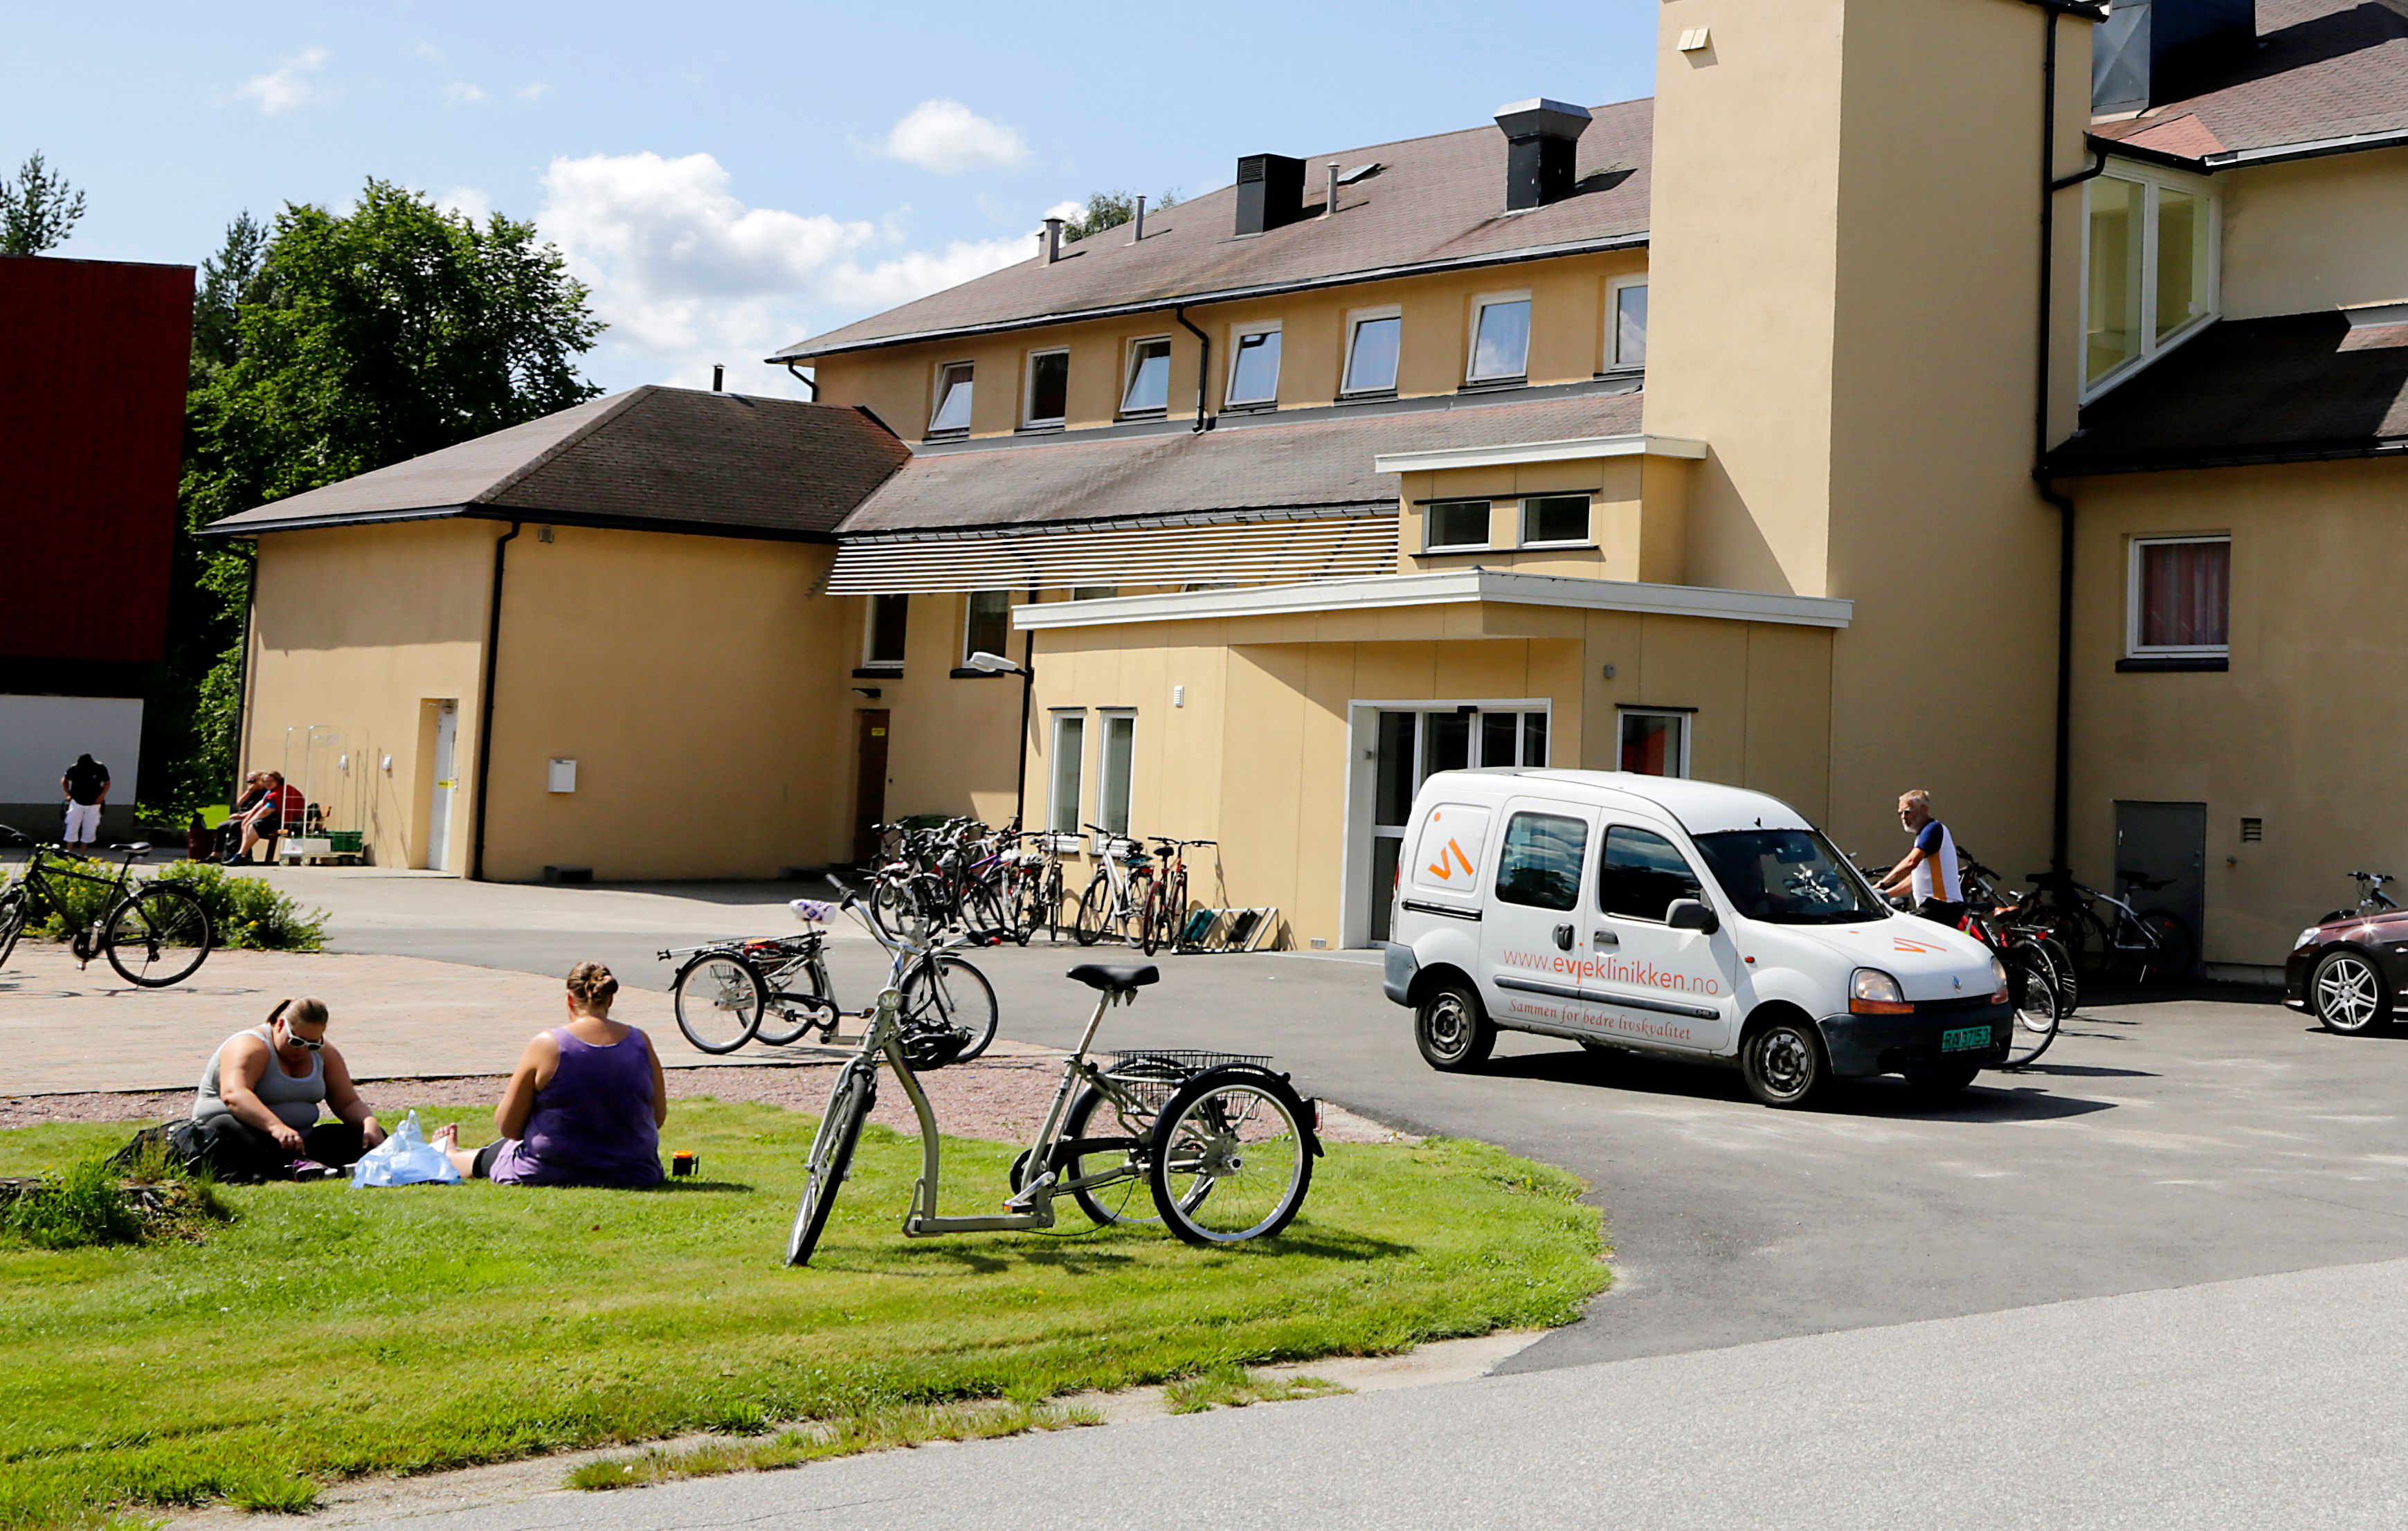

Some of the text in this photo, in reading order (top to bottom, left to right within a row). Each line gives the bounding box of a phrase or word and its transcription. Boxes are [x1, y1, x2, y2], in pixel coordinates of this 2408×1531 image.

[1503, 942, 1719, 995] www.evjeklinikken.no
[1509, 998, 1691, 1040] Sammen for bedre livskvalitet
